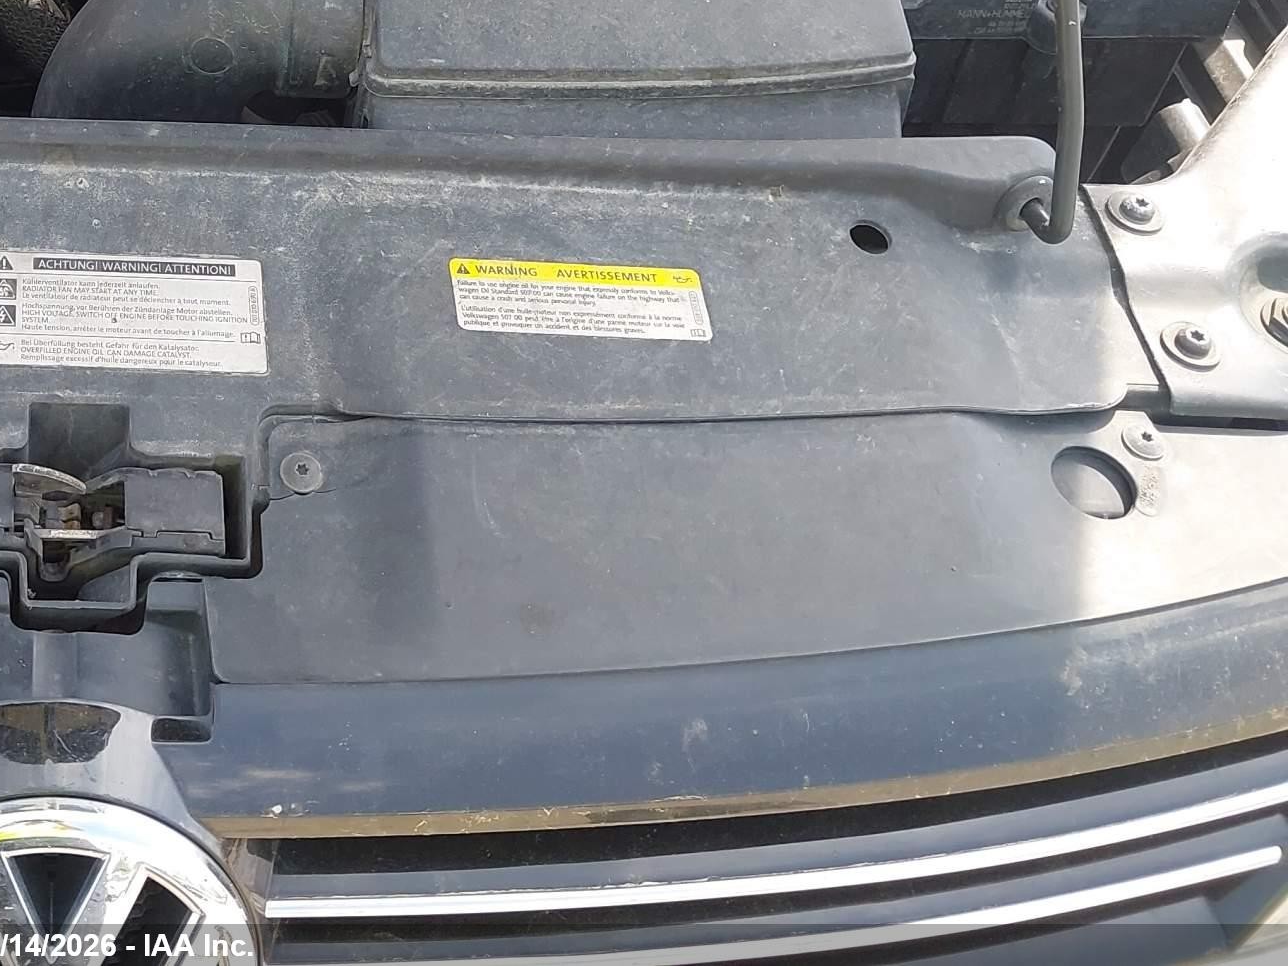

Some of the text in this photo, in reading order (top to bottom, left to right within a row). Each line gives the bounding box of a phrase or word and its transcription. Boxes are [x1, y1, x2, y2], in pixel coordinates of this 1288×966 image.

[38, 259, 231, 275] ACHTUNG! WARNING! ATTENTION!
[475, 265, 657, 283] WARNING AVERTISSEMENT
[22, 285, 57, 293] RADIATOR
[113, 296, 128, 304] peut
[551, 298, 577, 306] personal
[639, 296, 665, 304] highway
[176, 315, 213, 323] TOUCHING
[33, 340, 74, 349] Überfüllung
[20, 346, 62, 354] OVERFILLED
[157, 351, 192, 359] CATALYST.
[20, 354, 64, 363] Remplissage
[120, 357, 157, 366] dangereux
